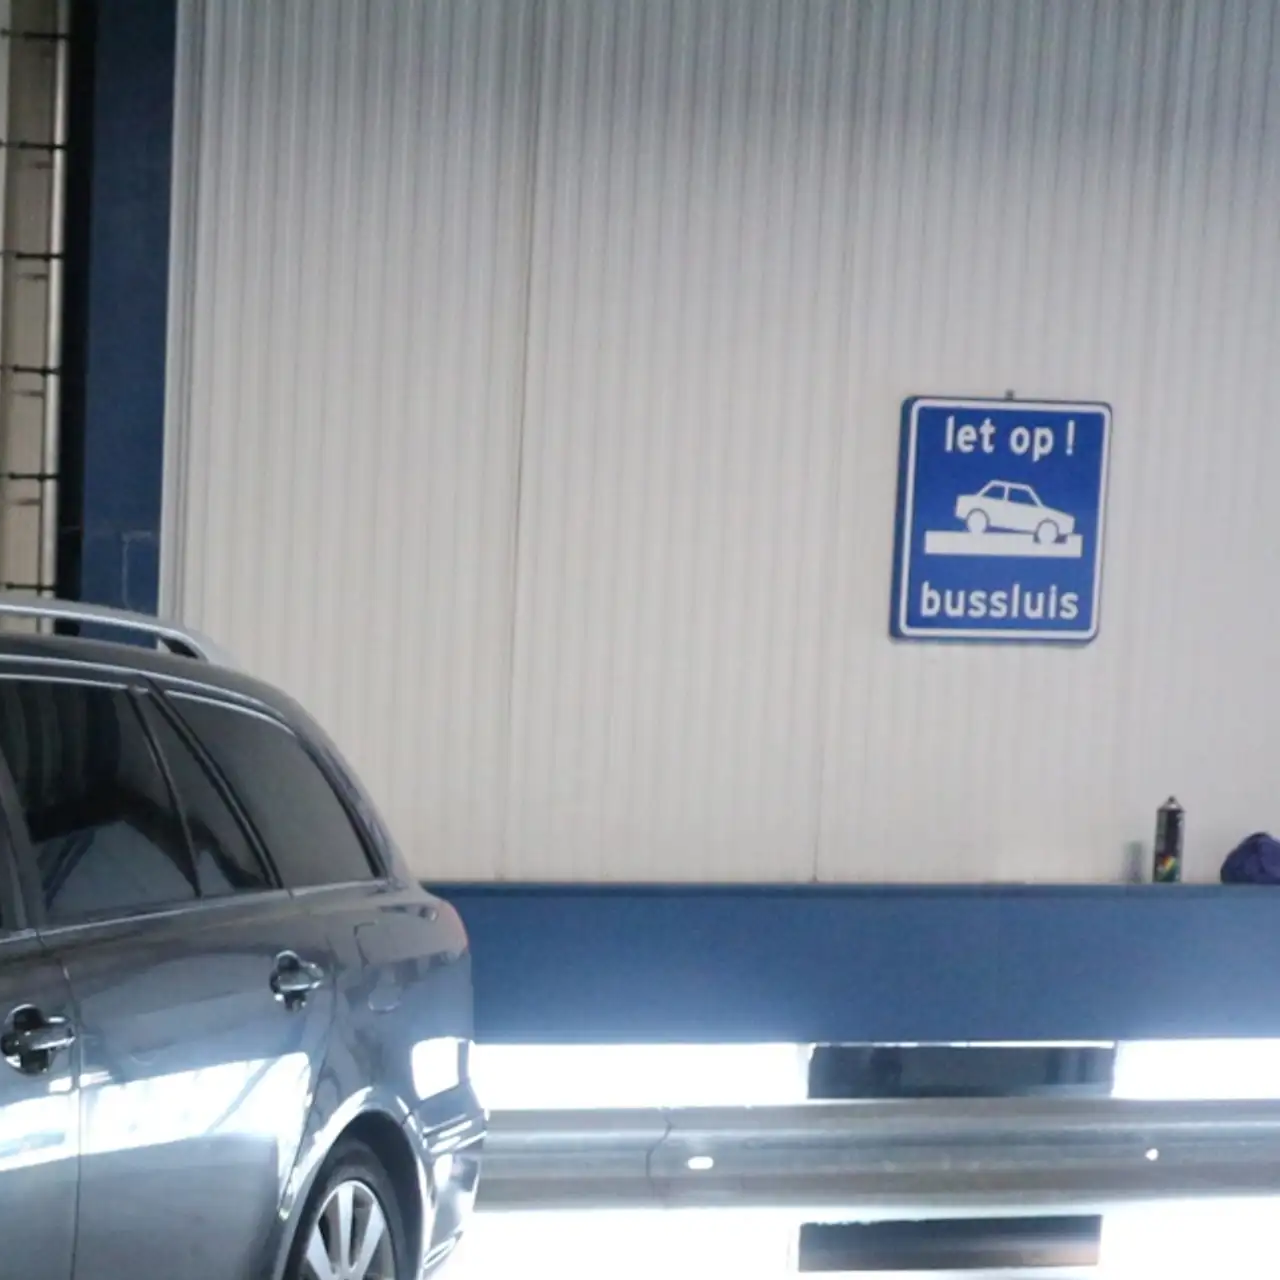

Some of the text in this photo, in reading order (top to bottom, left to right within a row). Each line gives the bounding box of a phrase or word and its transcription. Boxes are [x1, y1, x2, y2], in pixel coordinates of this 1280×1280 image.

[945, 415, 996, 454] let
[1010, 426, 1054, 463] op
[920, 580, 1079, 620] bussluis
